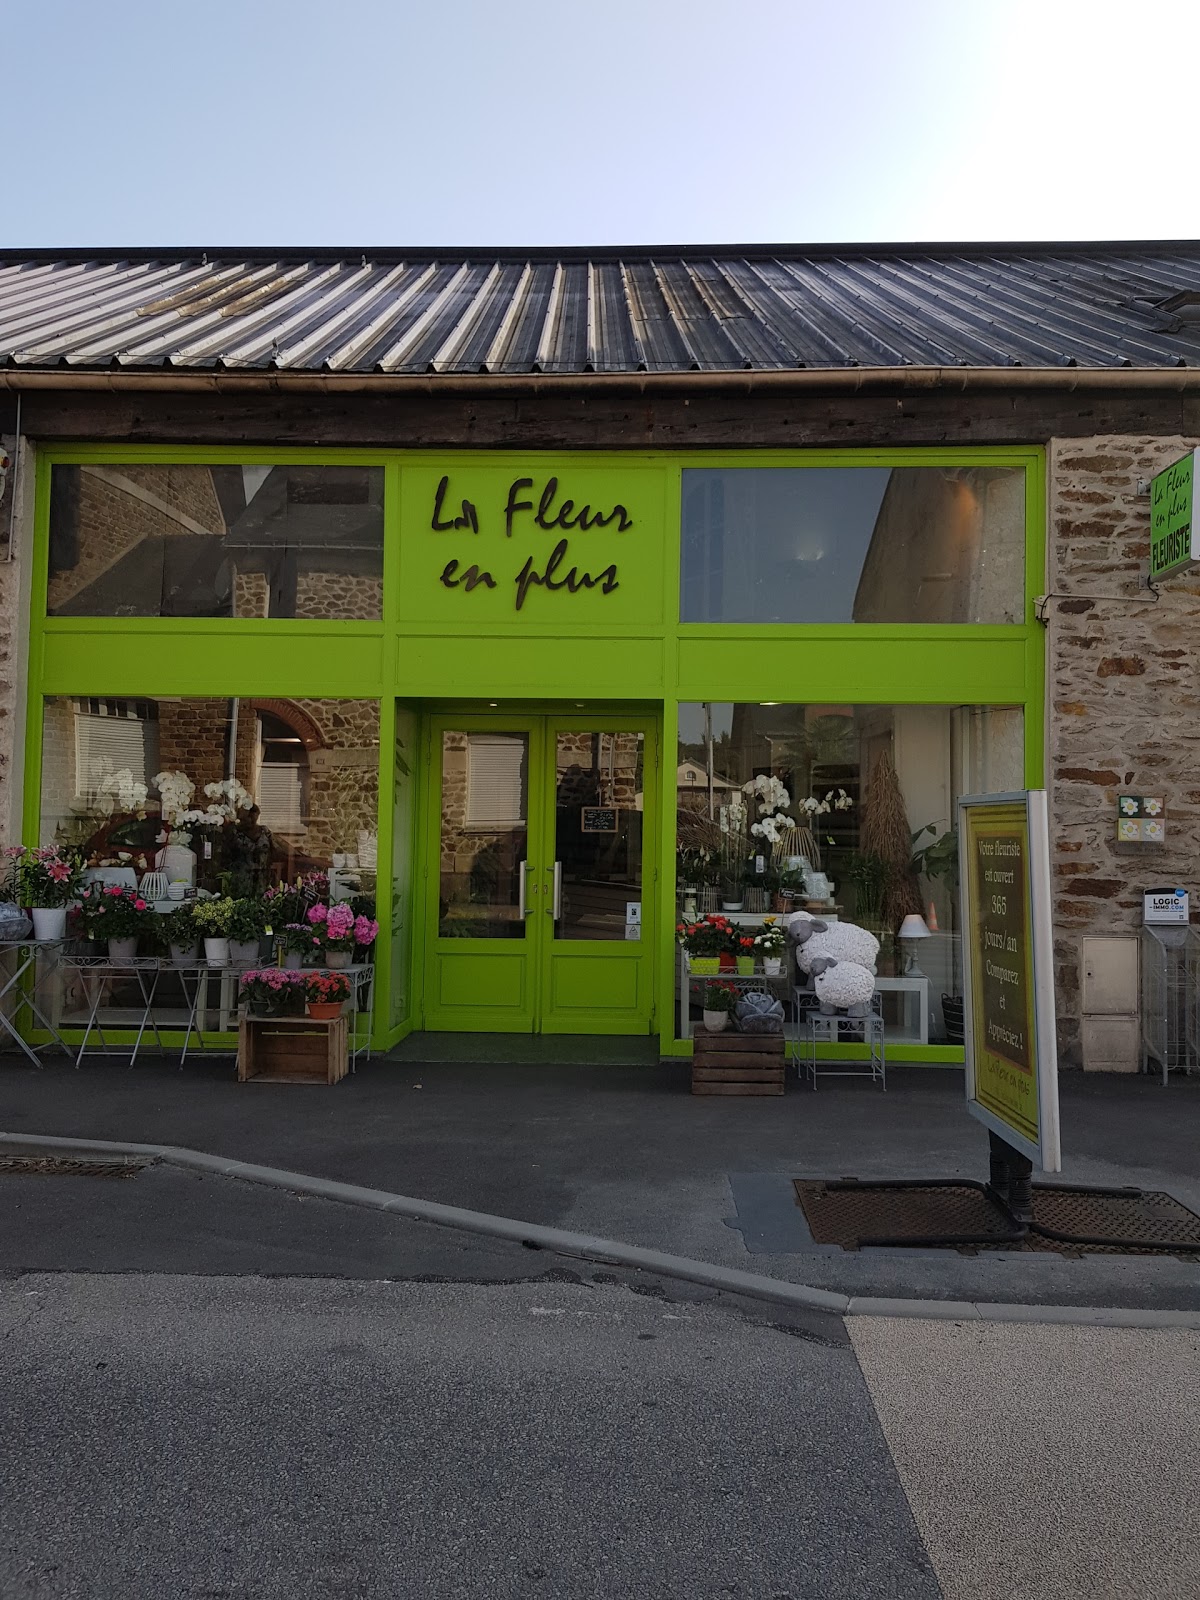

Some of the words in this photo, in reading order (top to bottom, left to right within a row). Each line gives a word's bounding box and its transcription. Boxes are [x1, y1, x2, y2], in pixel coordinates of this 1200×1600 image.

[1154, 481, 1163, 506] La
[1166, 468, 1190, 499] Fleur
[432, 475, 478, 534] La
[504, 477, 633, 537] Fleur
[1155, 513, 1165, 527] en
[1167, 493, 1187, 529] plus
[1152, 522, 1190, 573] FLEURISTE
[440, 559, 497, 592] en
[515, 538, 619, 611] plus
[978, 840, 994, 856] Votre
[994, 840, 1021, 857] fleuriste
[984, 868, 993, 882] est
[993, 869, 1014, 884] ouvert
[991, 894, 1007, 915] 365
[986, 959, 1019, 985] Comparez
[999, 995, 1006, 1010] et
